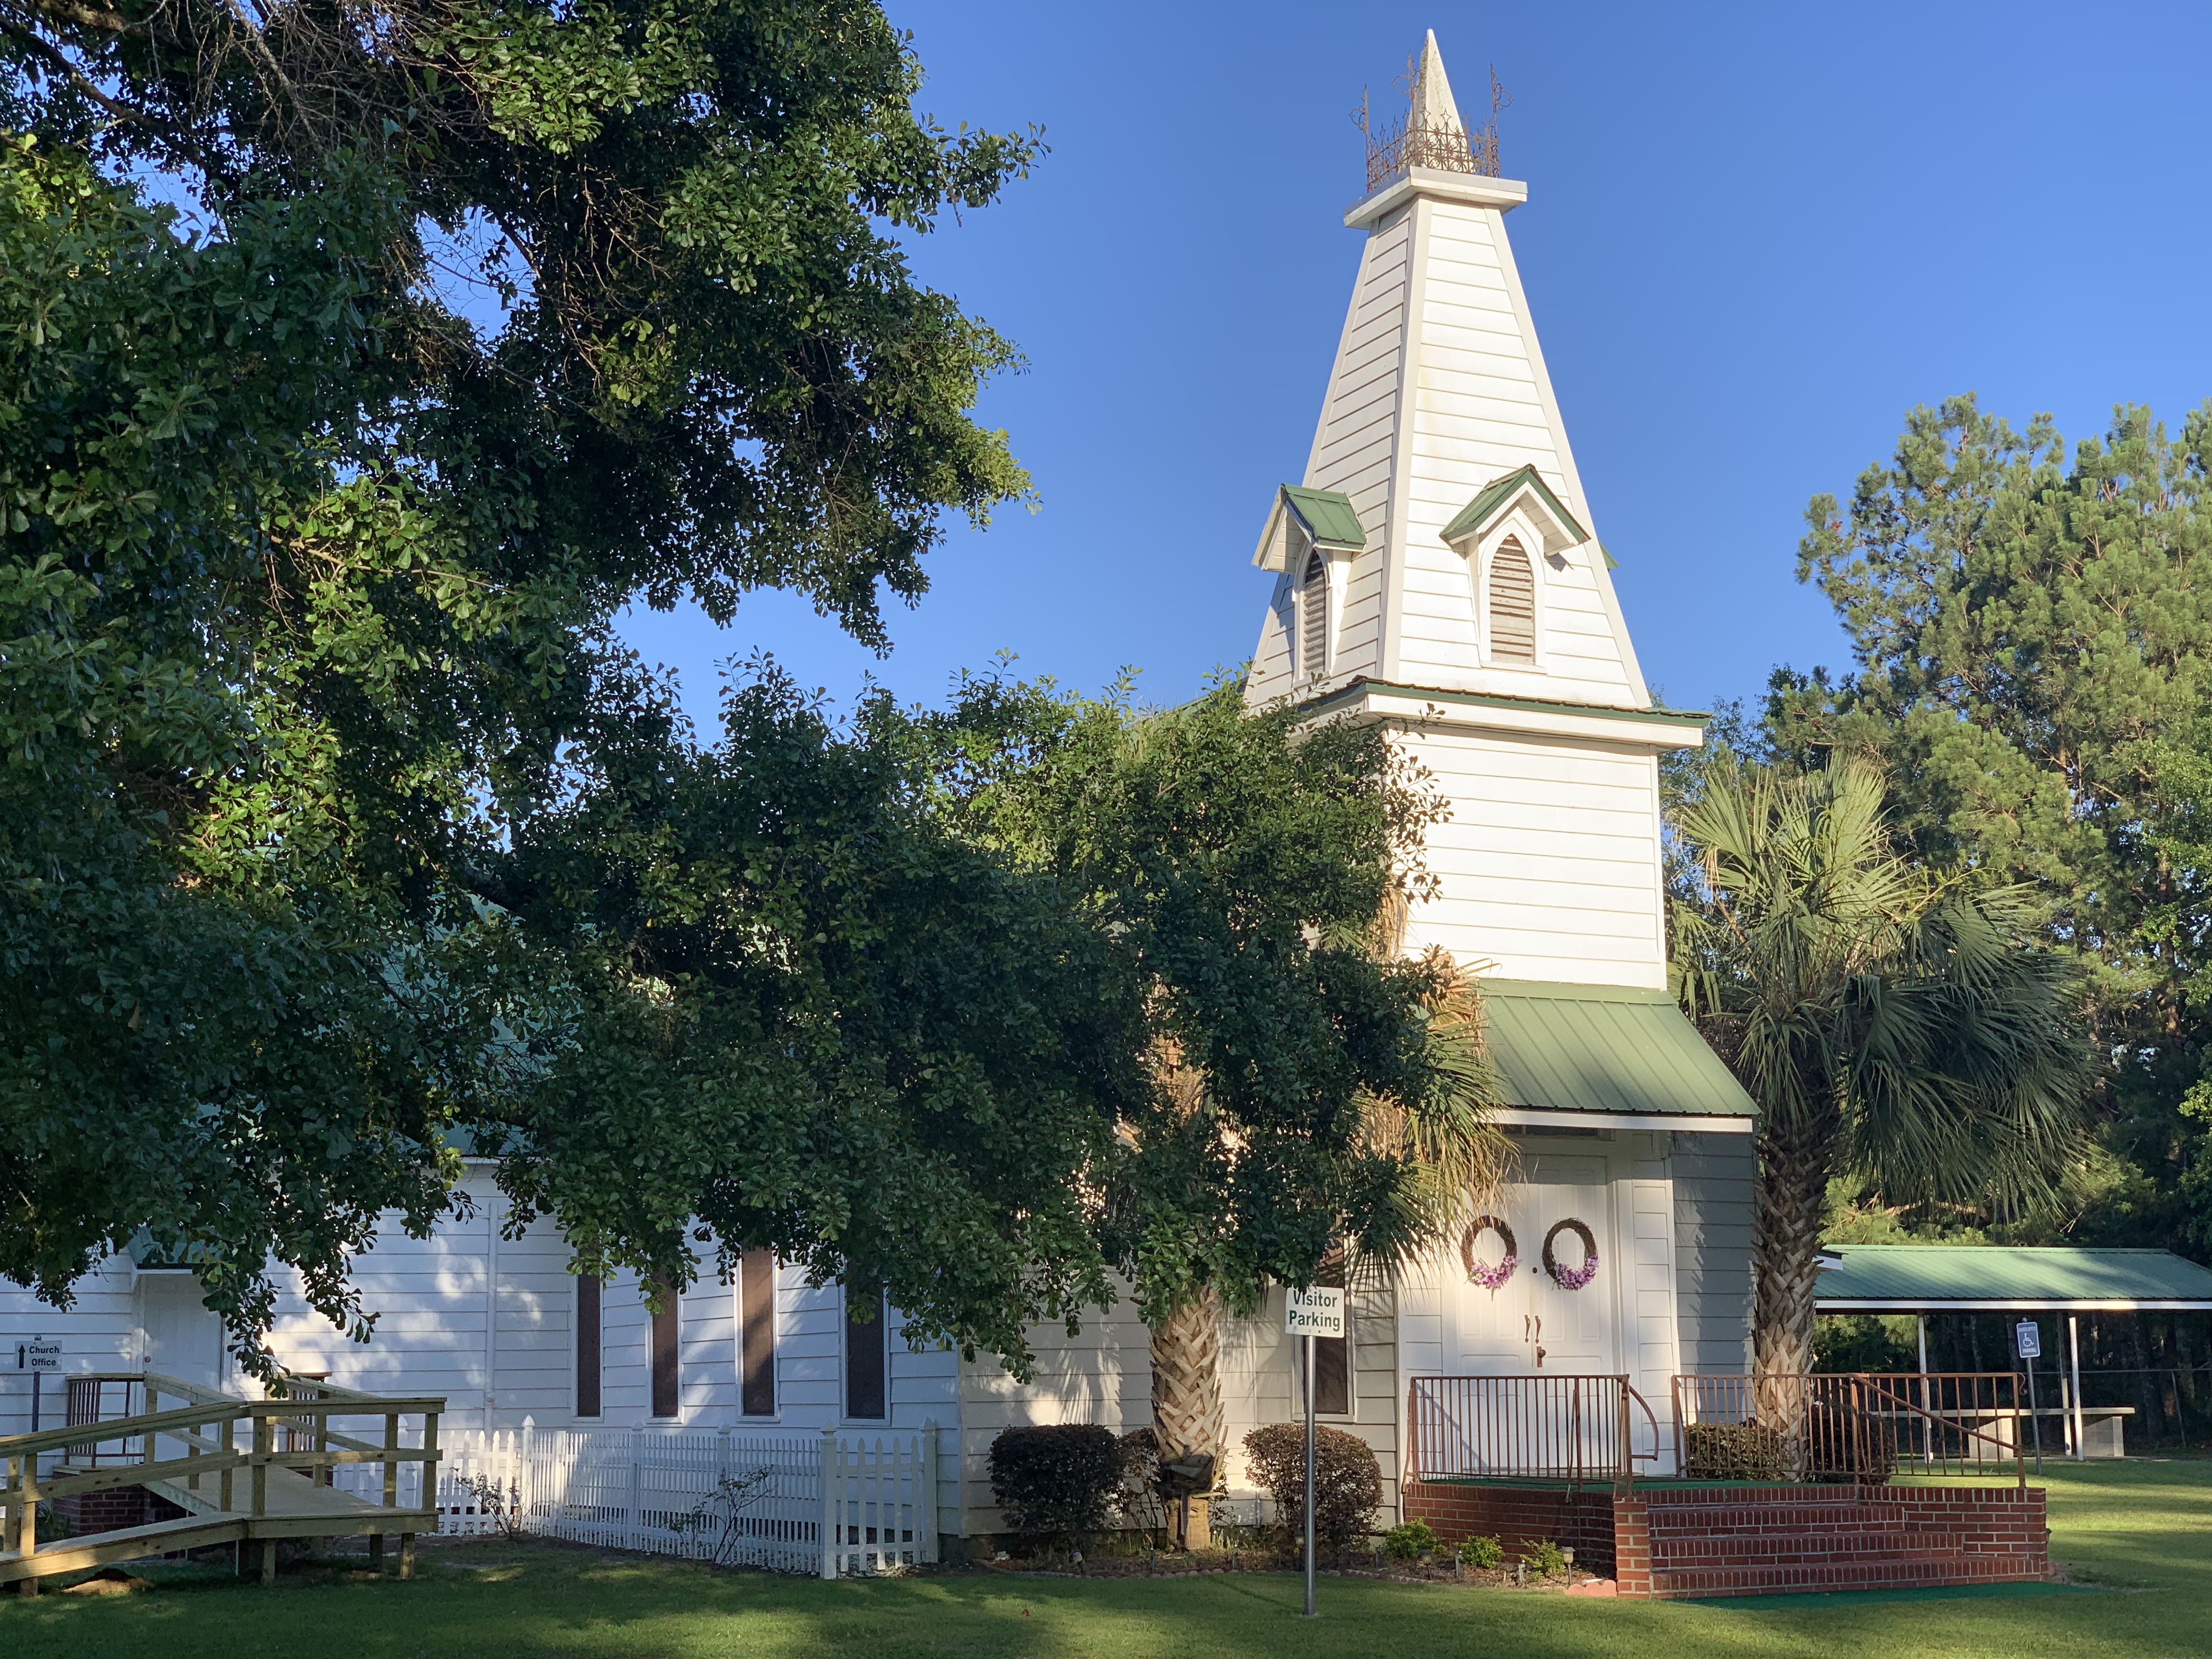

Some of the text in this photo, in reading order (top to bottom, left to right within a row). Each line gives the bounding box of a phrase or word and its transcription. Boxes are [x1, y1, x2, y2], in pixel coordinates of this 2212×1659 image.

[1293, 1290, 1337, 1307] Visitor
[1289, 1310, 1340, 1332] Parking
[29, 1346, 60, 1354] Church
[31, 1358, 57, 1366] Office
